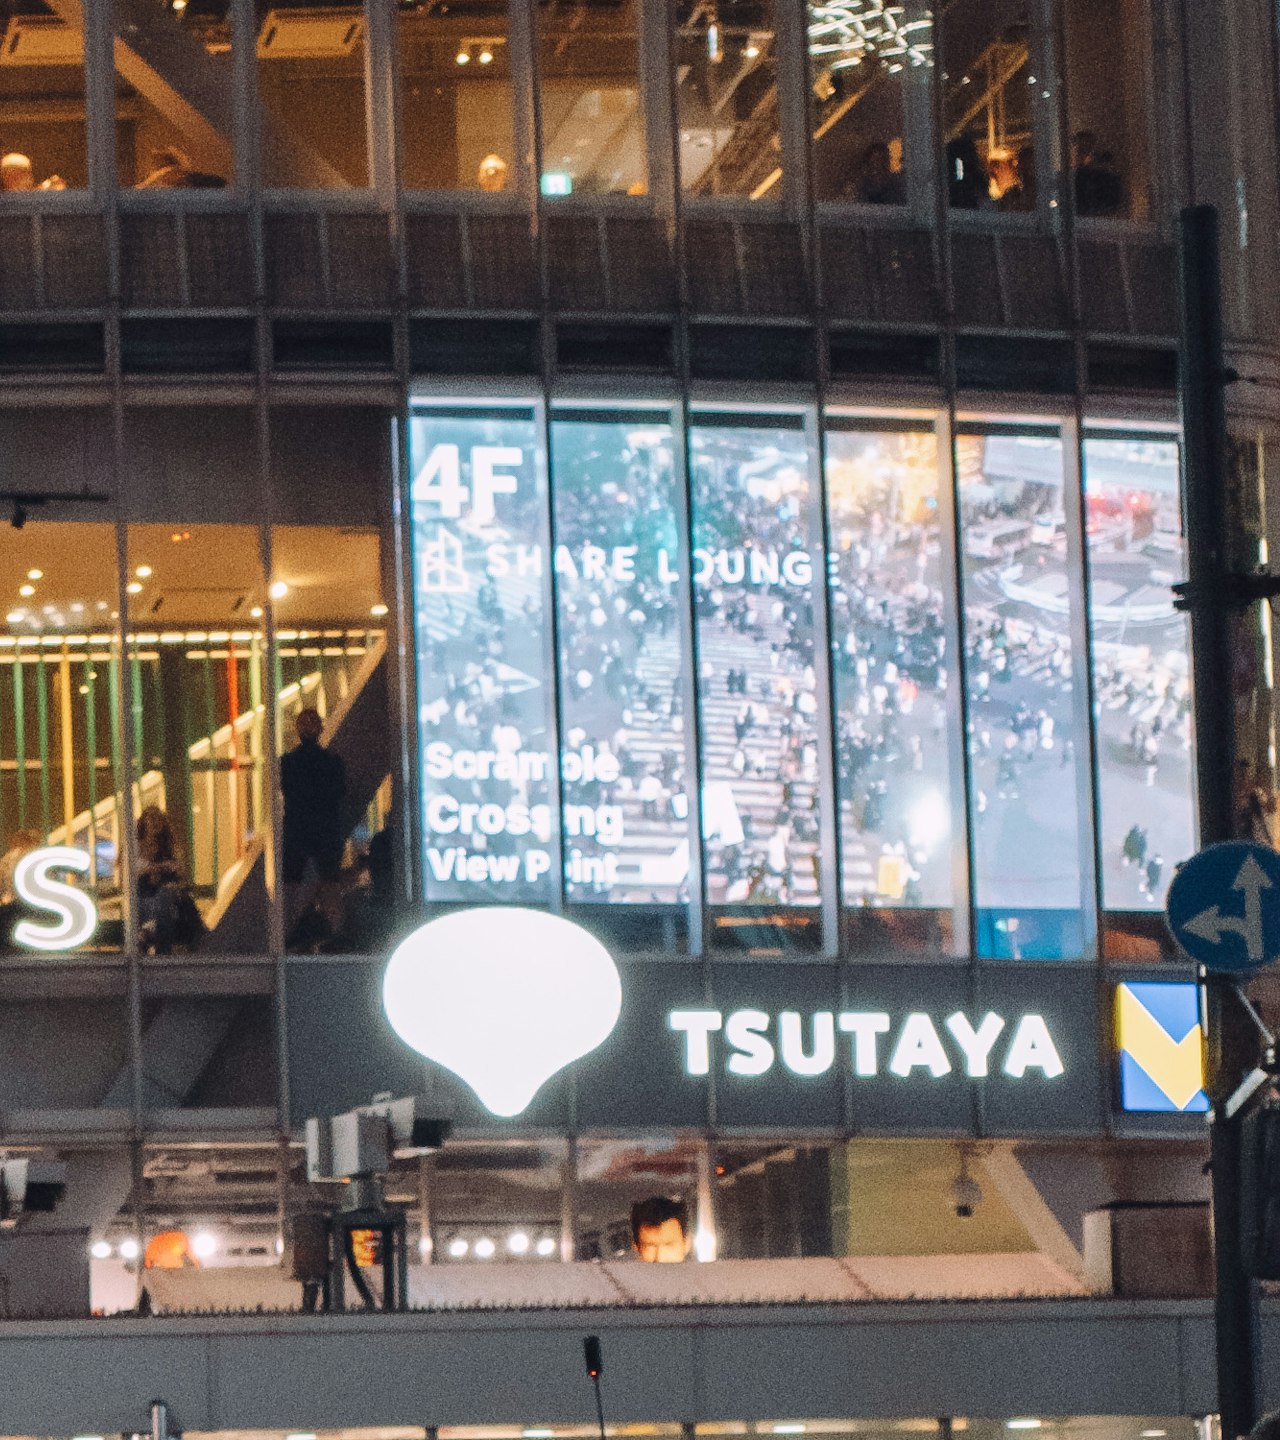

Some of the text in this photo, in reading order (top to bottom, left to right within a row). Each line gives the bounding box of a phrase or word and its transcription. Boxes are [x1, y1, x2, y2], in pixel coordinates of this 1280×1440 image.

[412, 443, 523, 519] 4F
[486, 544, 841, 587] SHARE LOUNGE
[426, 846, 619, 883] View Pint
[669, 1010, 1064, 1079] TSUTAYA
